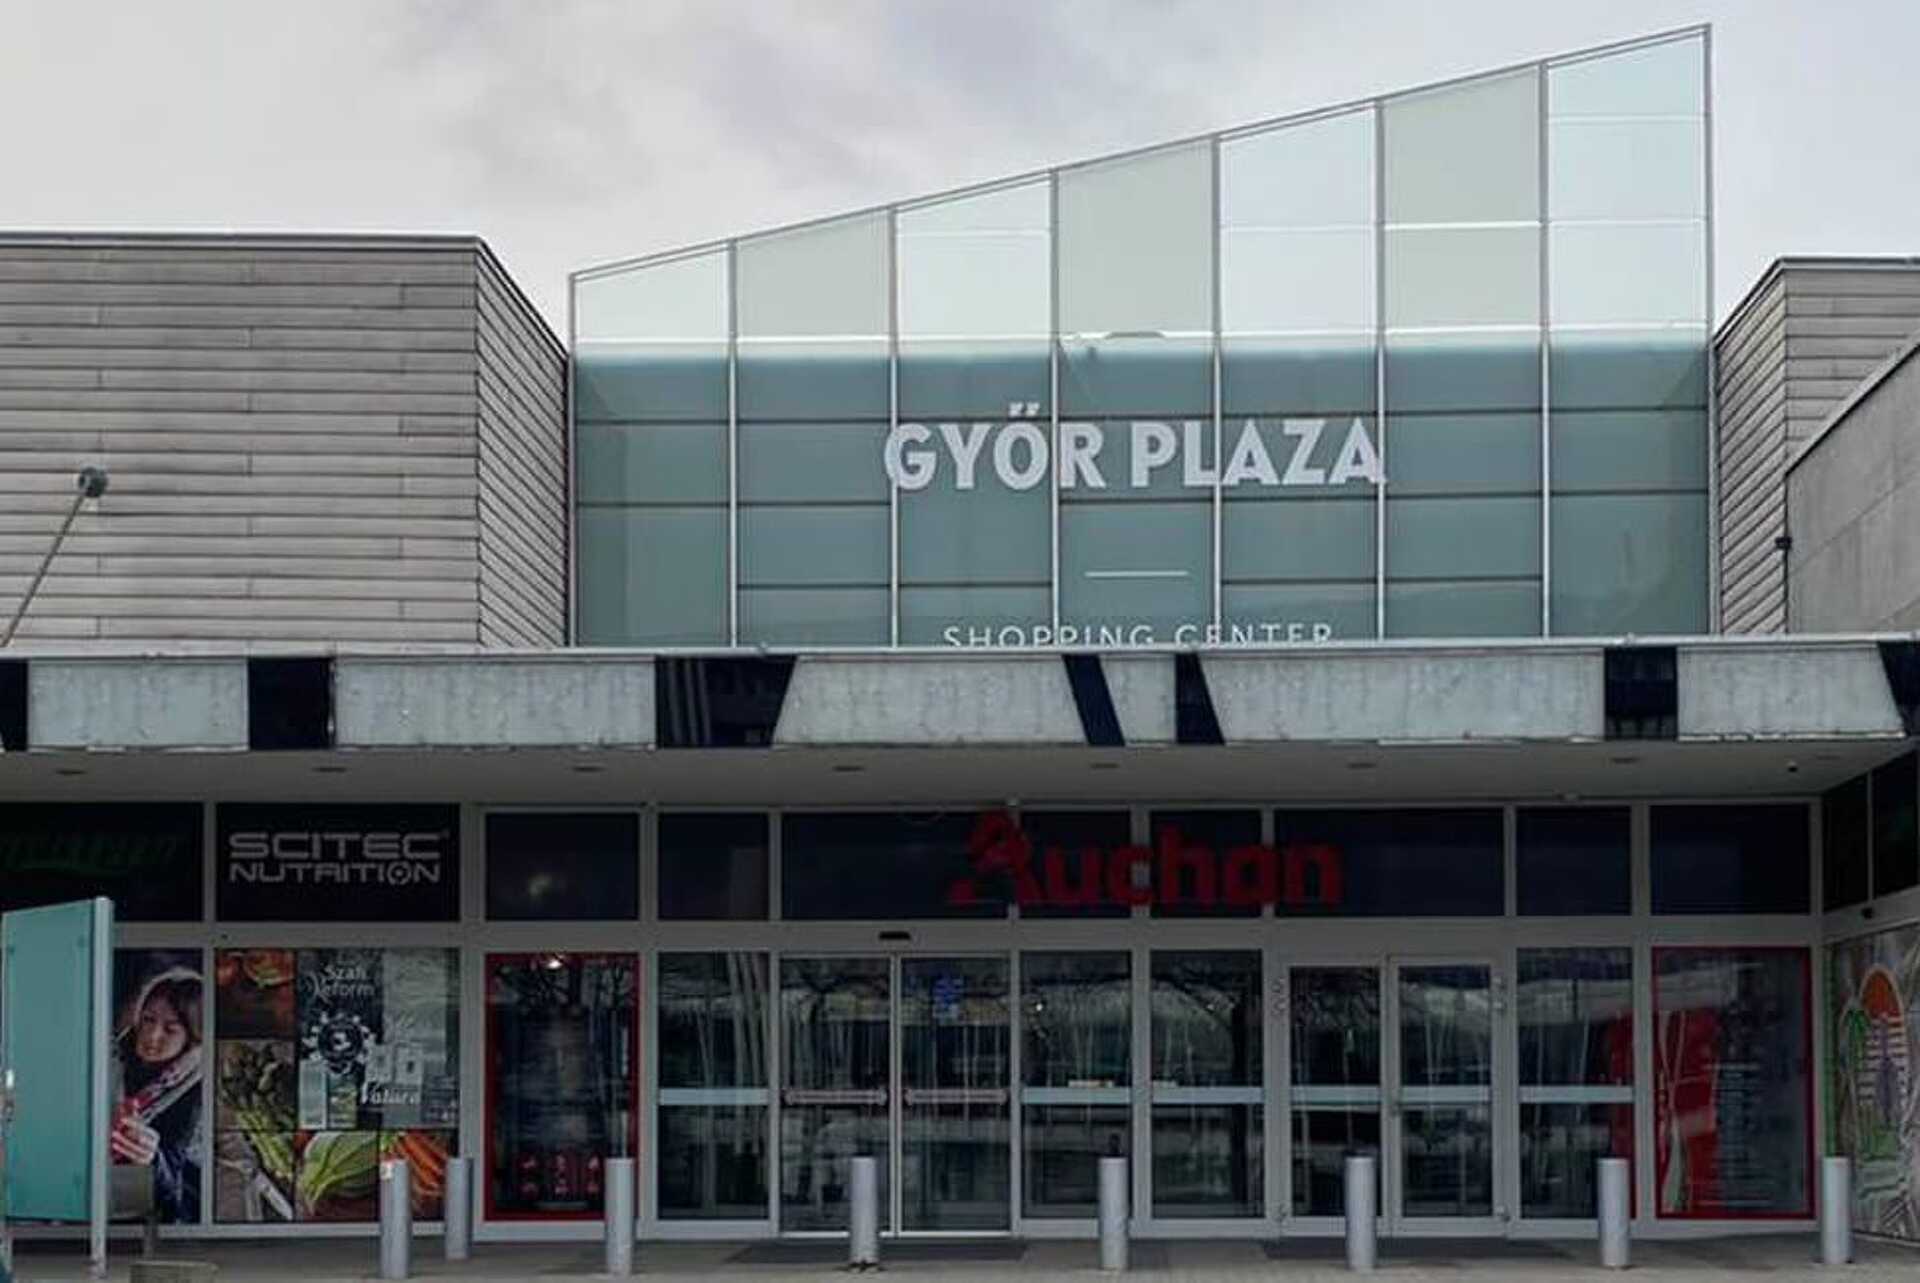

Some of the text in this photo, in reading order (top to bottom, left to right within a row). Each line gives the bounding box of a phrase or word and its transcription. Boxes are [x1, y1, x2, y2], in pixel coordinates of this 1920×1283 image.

[884, 403, 1385, 490] GYŐR PLAZA
[943, 624, 1331, 647] SHOPPING CENTER
[229, 832, 441, 860] SCITEC
[949, 812, 1343, 907] Auchan
[229, 862, 441, 885] NUTRITION
